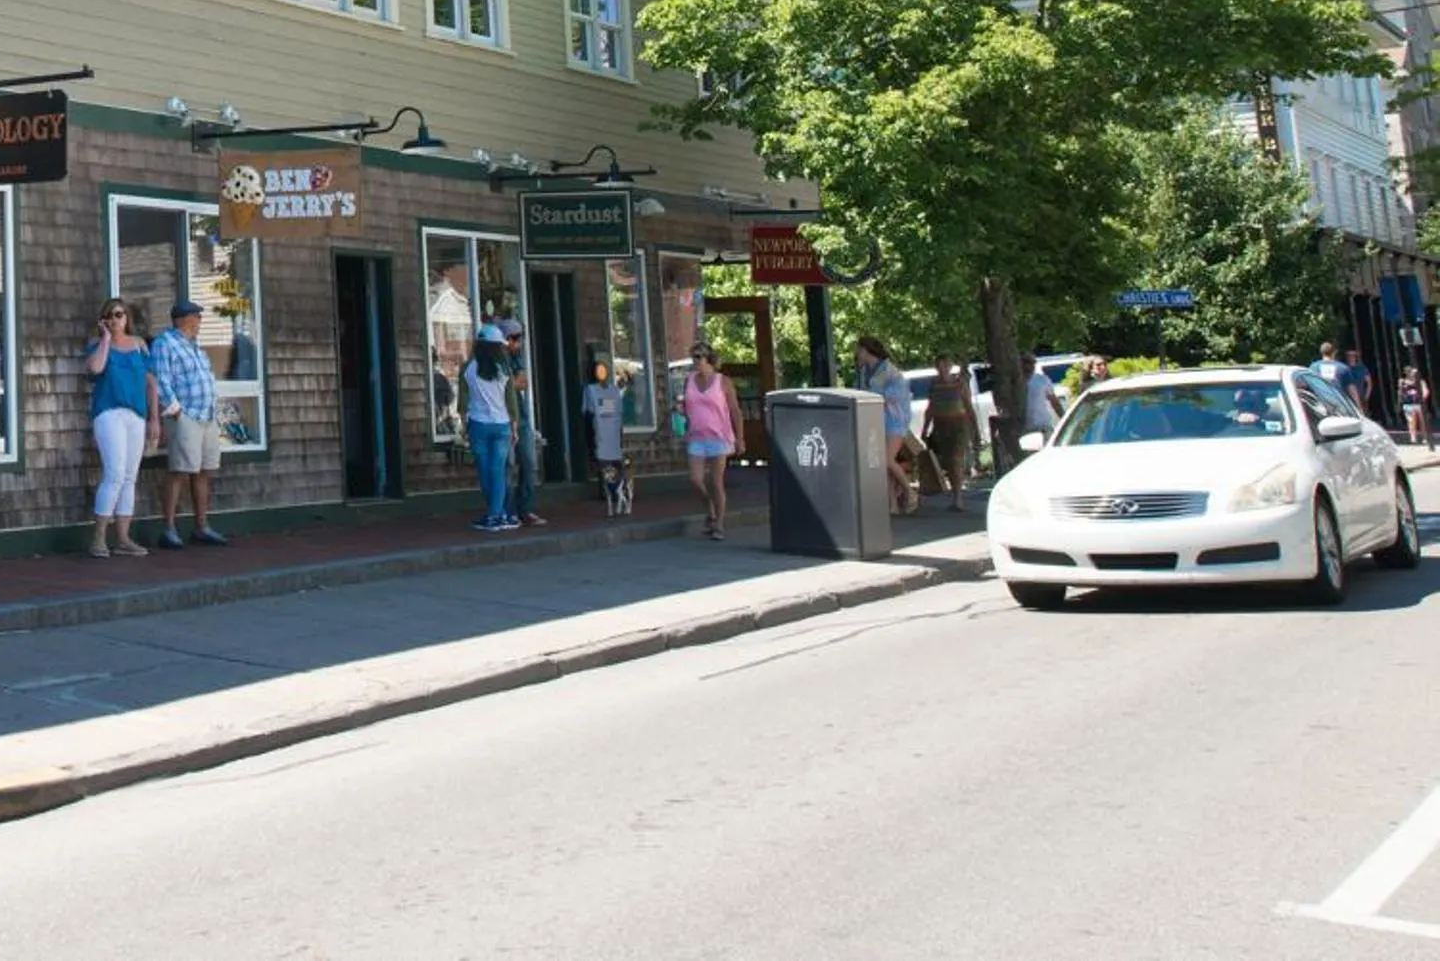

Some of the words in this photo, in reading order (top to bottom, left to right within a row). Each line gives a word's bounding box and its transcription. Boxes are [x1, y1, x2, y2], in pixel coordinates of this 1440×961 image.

[264, 169, 312, 192] BEN
[262, 190, 357, 219] JERRY'S
[530, 203, 623, 225] Stardust
